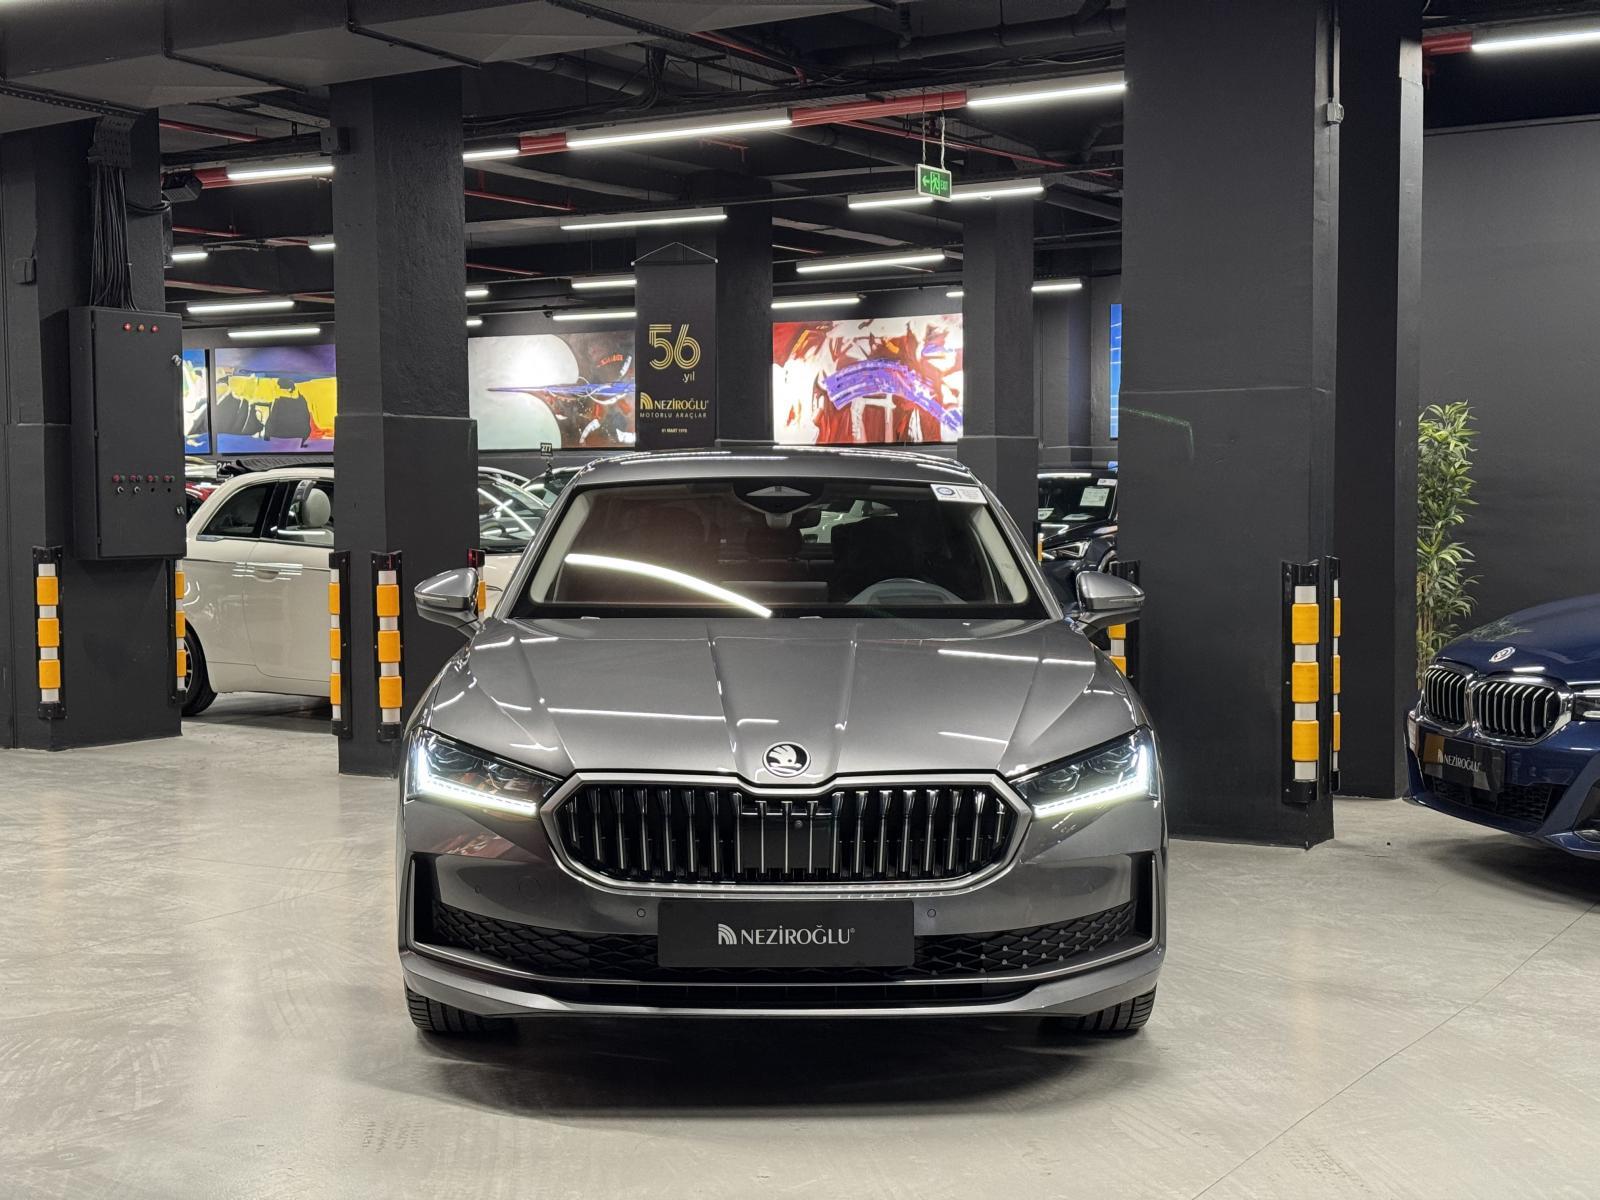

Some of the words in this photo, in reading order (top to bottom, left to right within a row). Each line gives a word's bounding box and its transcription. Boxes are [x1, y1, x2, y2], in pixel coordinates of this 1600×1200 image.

[648, 323, 701, 370] 56
[675, 412, 707, 420] ARAÇLAR
[740, 924, 851, 945] NEZİROĞLU
